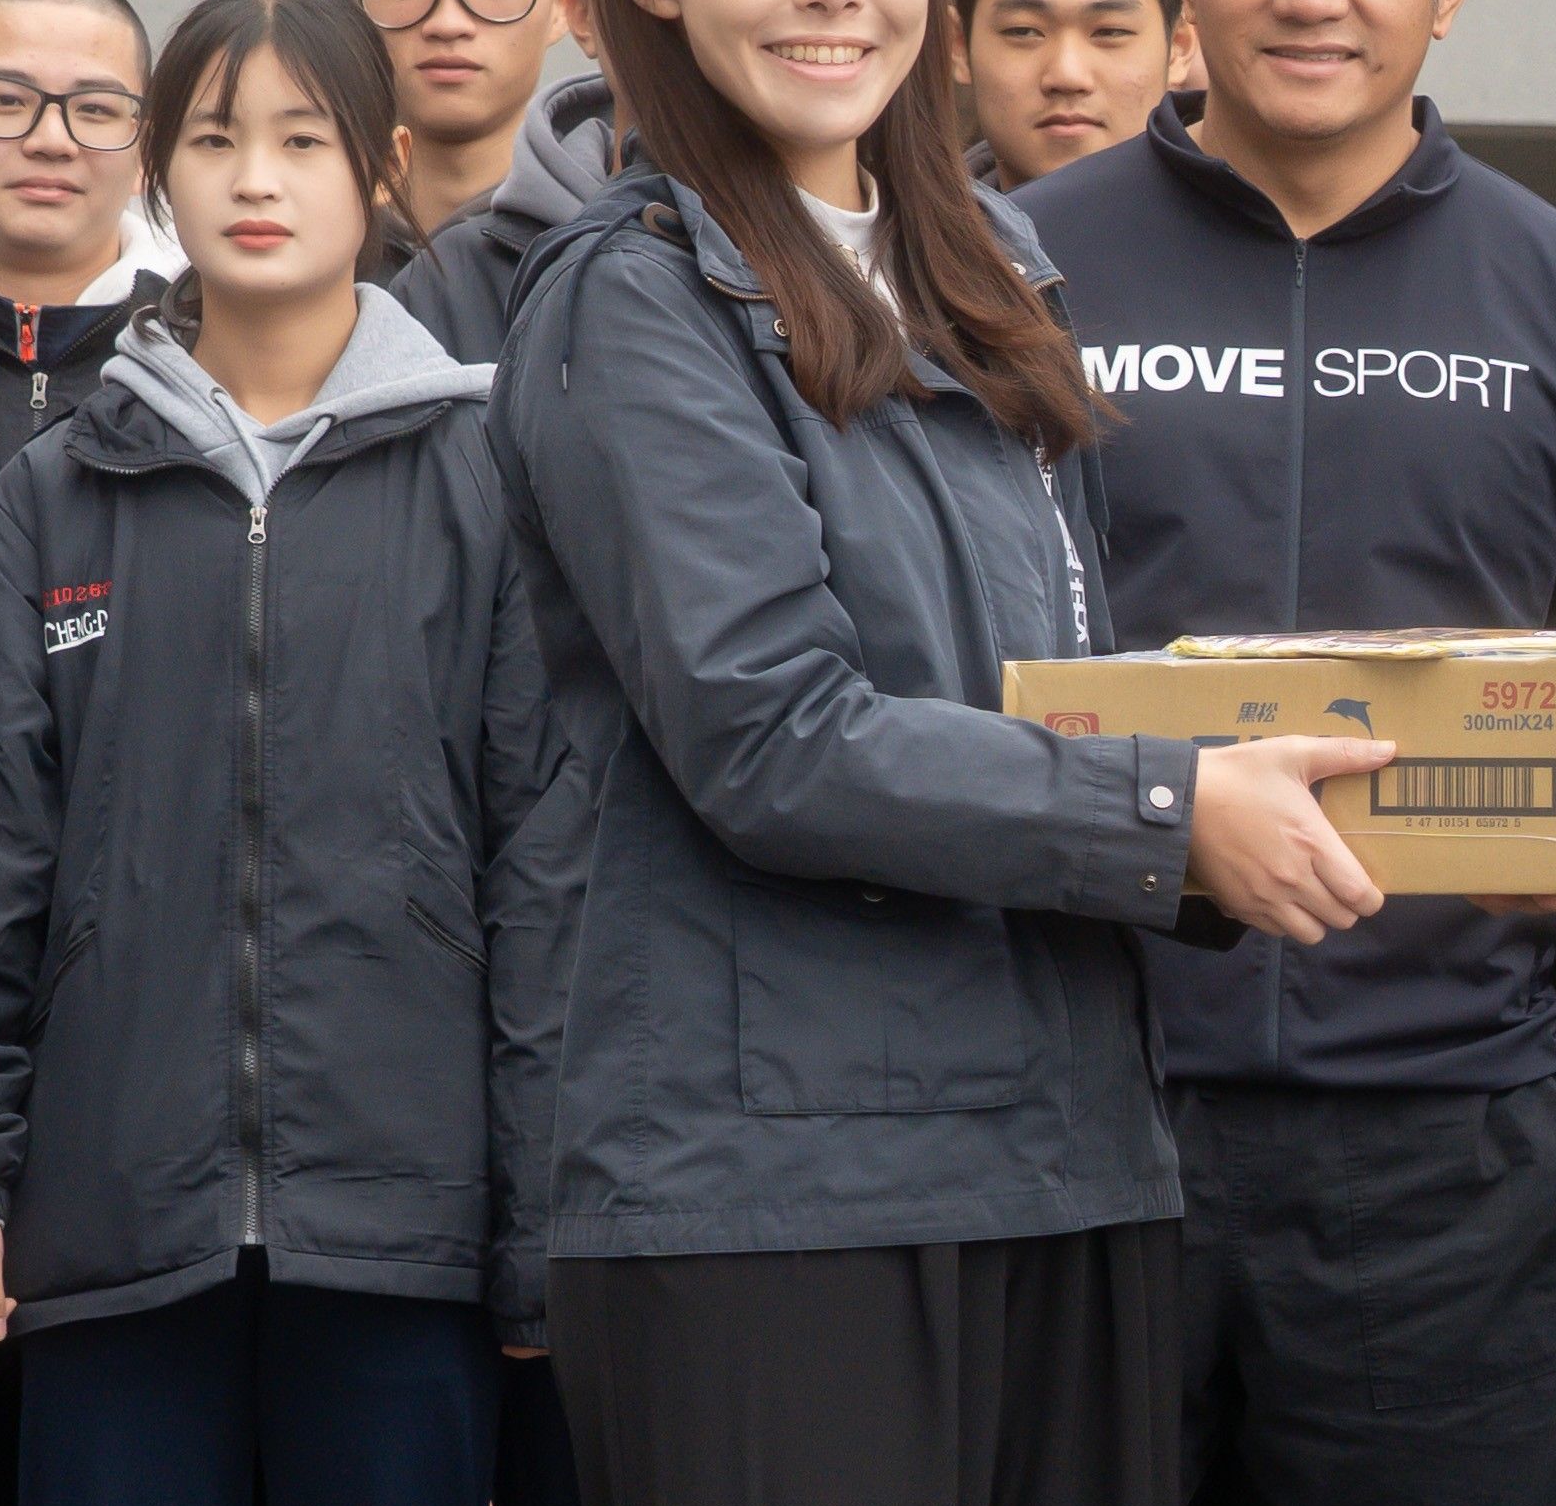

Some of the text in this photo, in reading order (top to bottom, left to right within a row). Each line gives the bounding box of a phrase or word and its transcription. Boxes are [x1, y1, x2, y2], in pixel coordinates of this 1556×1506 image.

[1080, 344, 1530, 412] MOVE SPORT
[1481, 681, 1556, 710] 5972
[1236, 702, 1278, 724] 黑松
[1463, 714, 1554, 731] 300mlX24
[1418, 817, 1432, 828] 47
